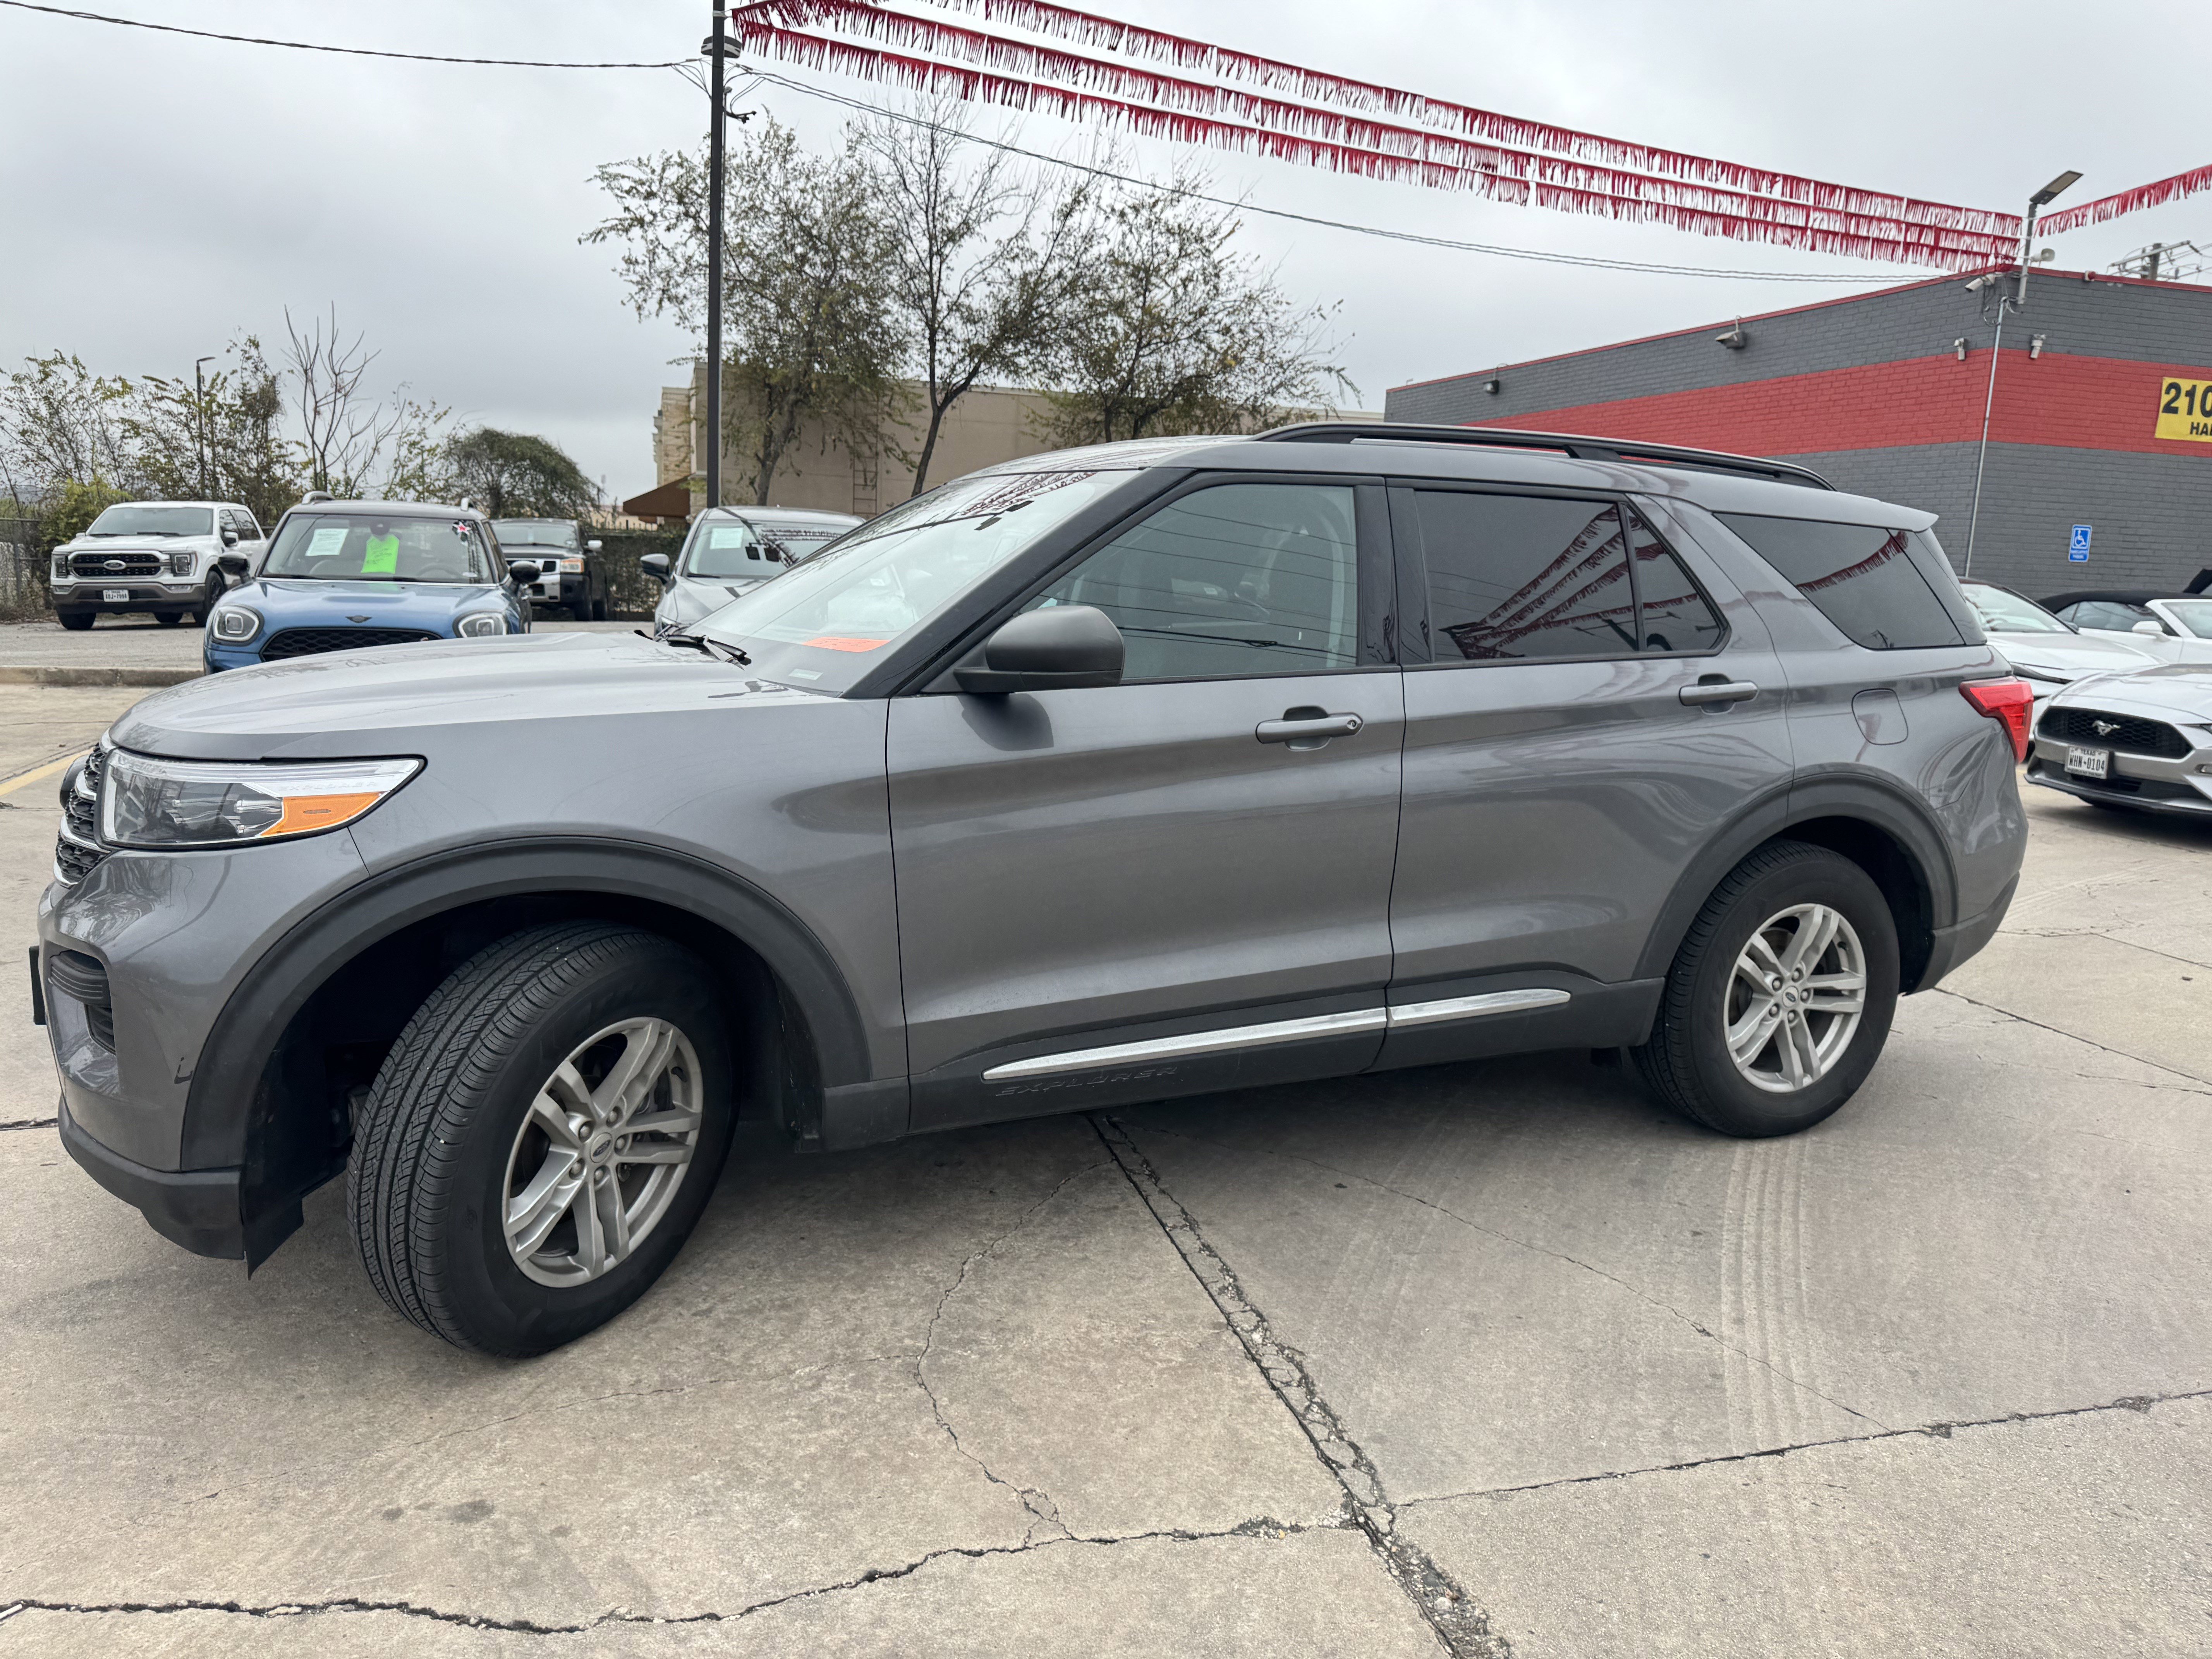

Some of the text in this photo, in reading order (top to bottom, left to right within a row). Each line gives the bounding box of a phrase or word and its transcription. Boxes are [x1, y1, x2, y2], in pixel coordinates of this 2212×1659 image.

[2162, 382, 2212, 418] 210
[2190, 422, 2212, 436] HA
[278, 781, 378, 792] EXPLORER
[995, 1066, 1178, 1096] EXPLORER
